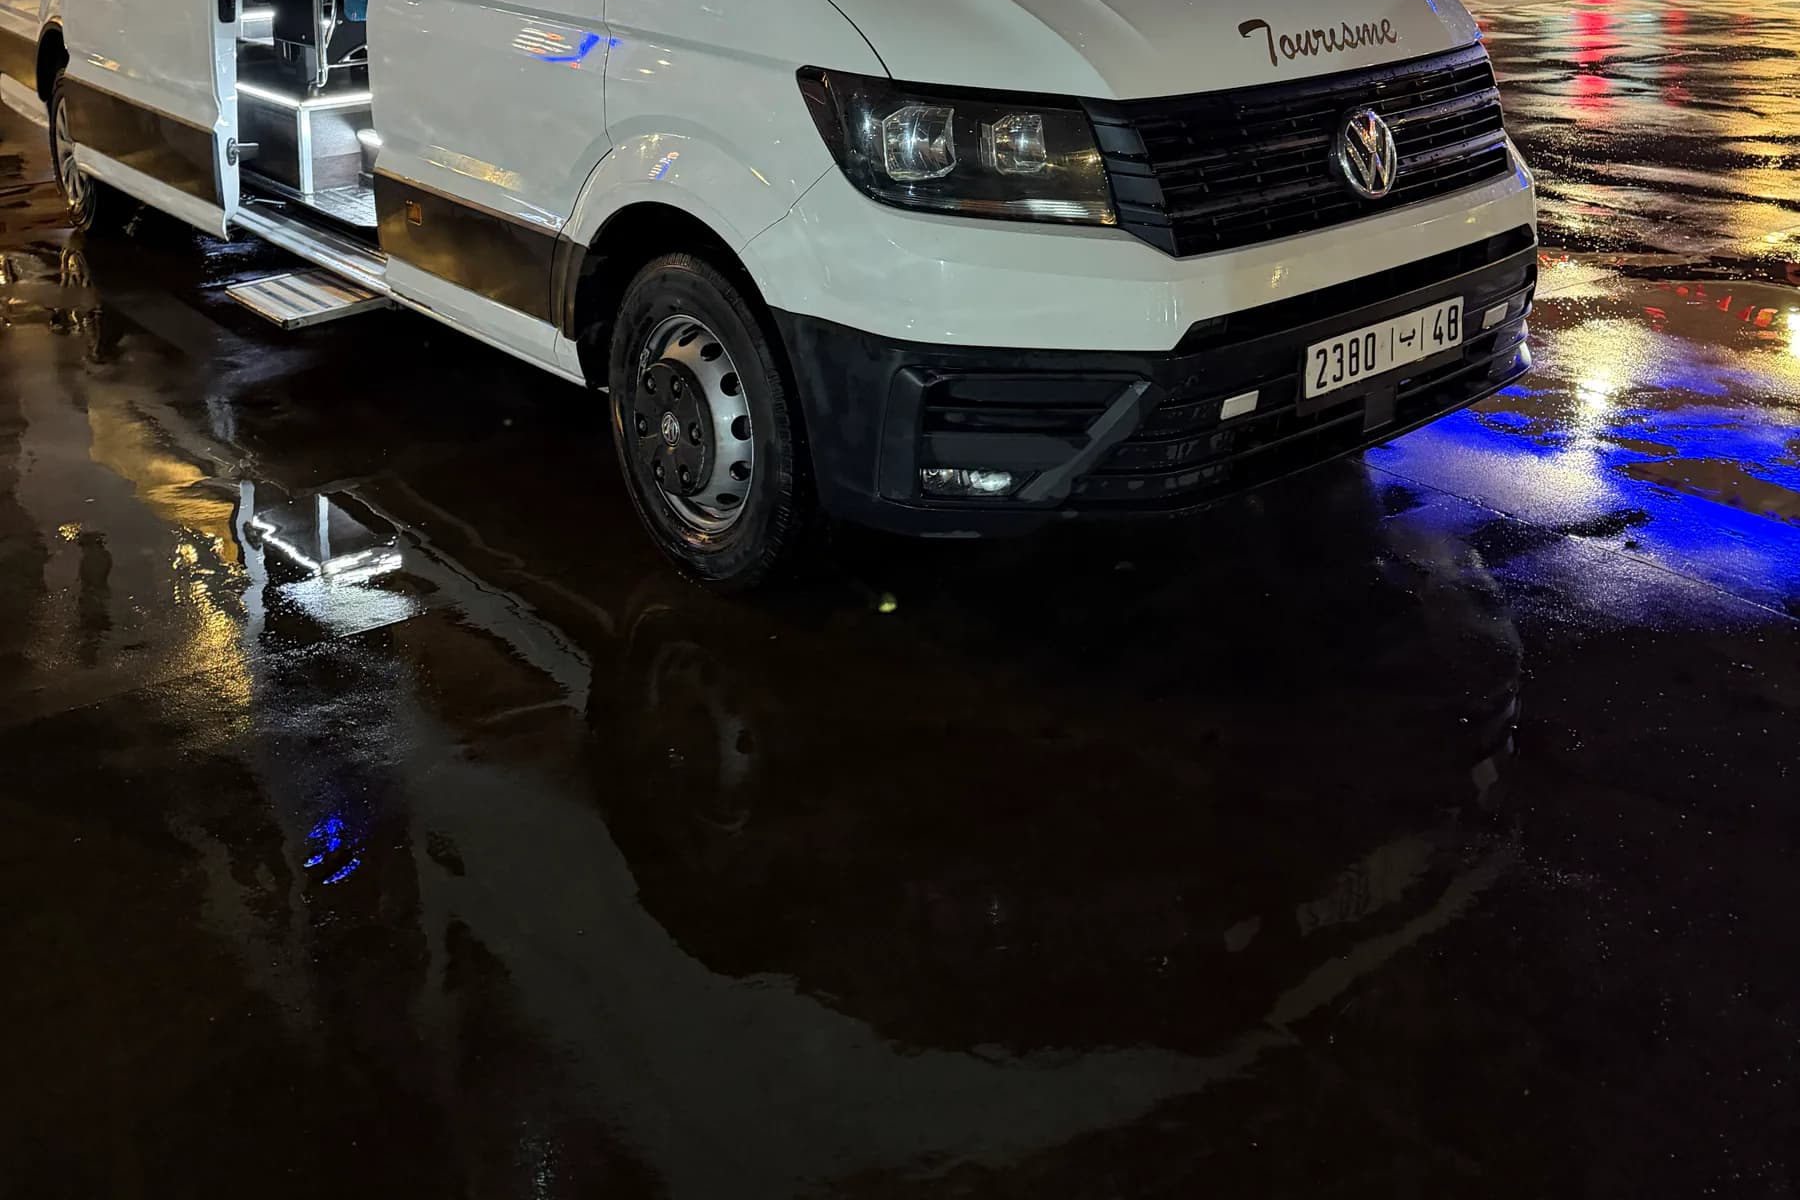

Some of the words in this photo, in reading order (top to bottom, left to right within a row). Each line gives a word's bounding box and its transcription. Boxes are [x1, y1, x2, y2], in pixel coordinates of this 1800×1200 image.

[1237, 18, 1398, 67] Tourisme
[1316, 332, 1376, 389] 2380
[1433, 304, 1459, 345] 48
